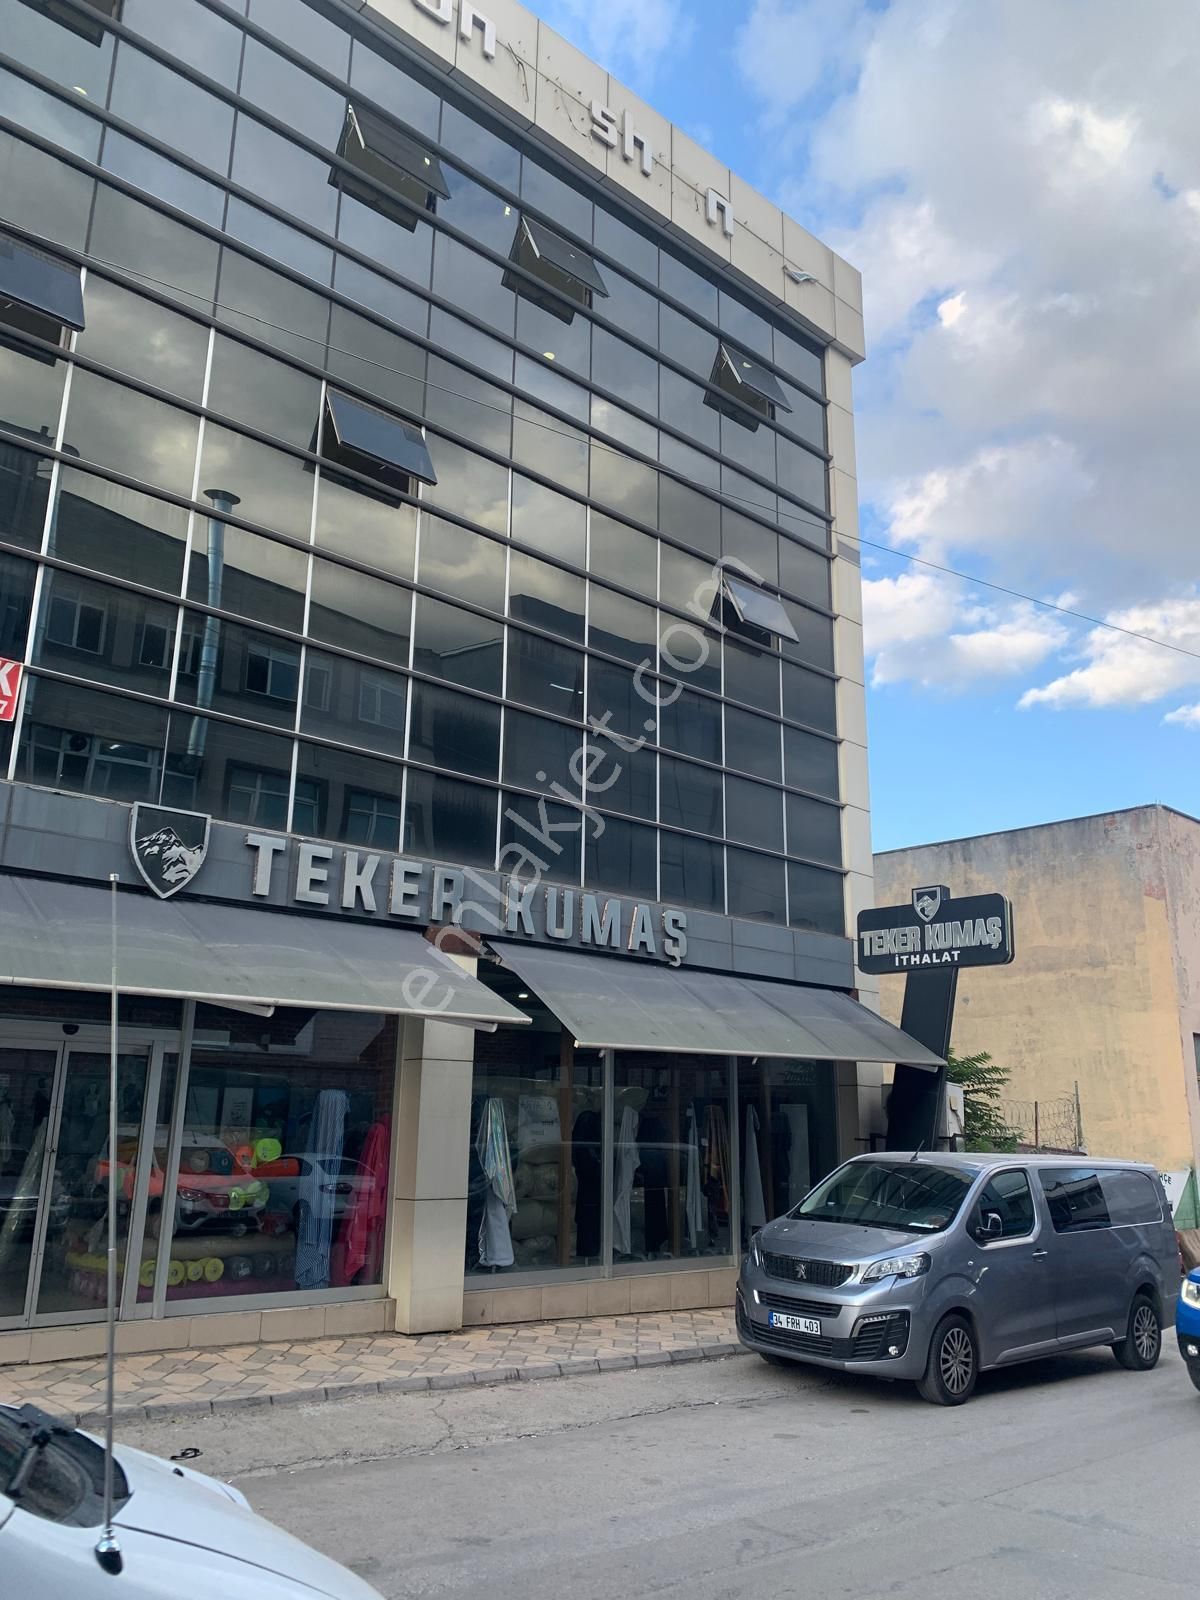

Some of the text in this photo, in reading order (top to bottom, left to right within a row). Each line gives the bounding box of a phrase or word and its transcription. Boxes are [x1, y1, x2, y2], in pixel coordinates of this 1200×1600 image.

[245, 832, 688, 967] TEKER KUMAŞ
[860, 916, 1003, 957] TEKER KUMAŞ
[895, 950, 961, 967] İTHALAT
[773, 1314, 819, 1333] 34 FRH 403
